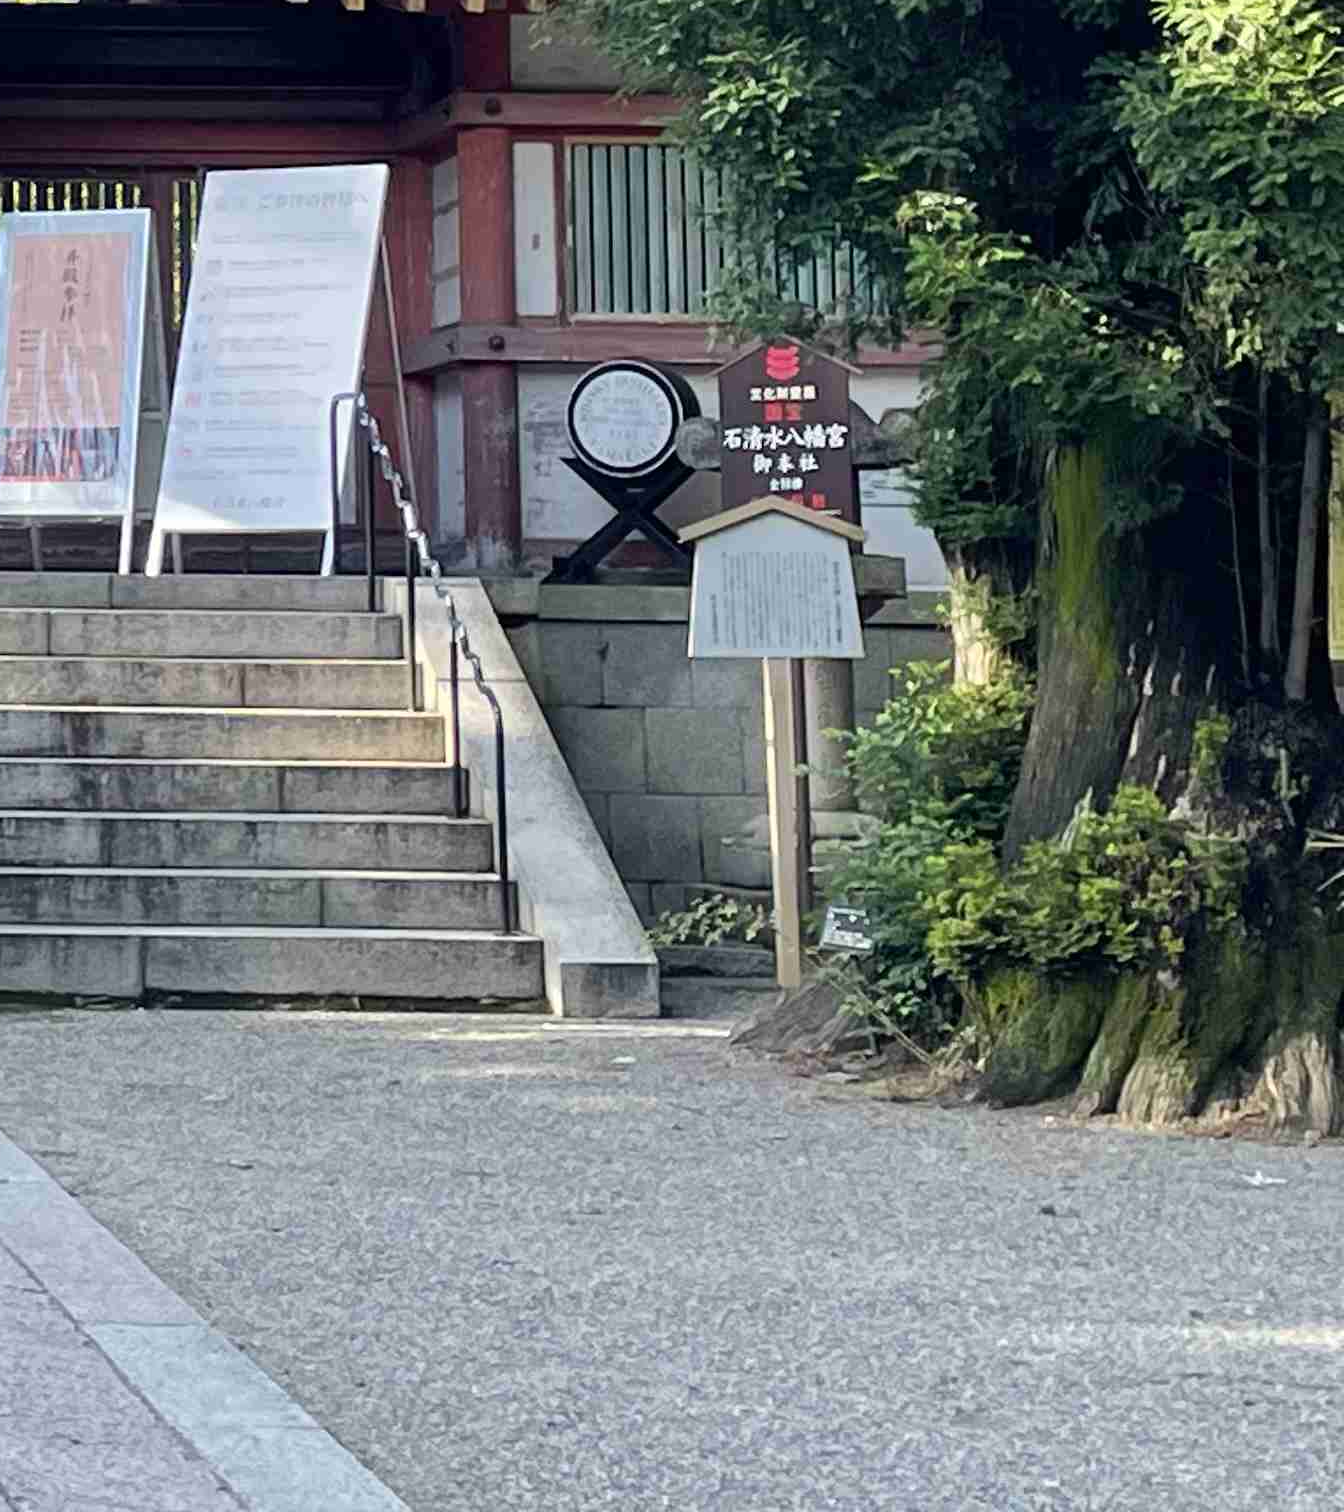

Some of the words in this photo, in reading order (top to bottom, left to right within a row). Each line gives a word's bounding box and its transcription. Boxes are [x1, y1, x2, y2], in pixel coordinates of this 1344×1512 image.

[723, 423, 848, 450] 石清水八幡宮
